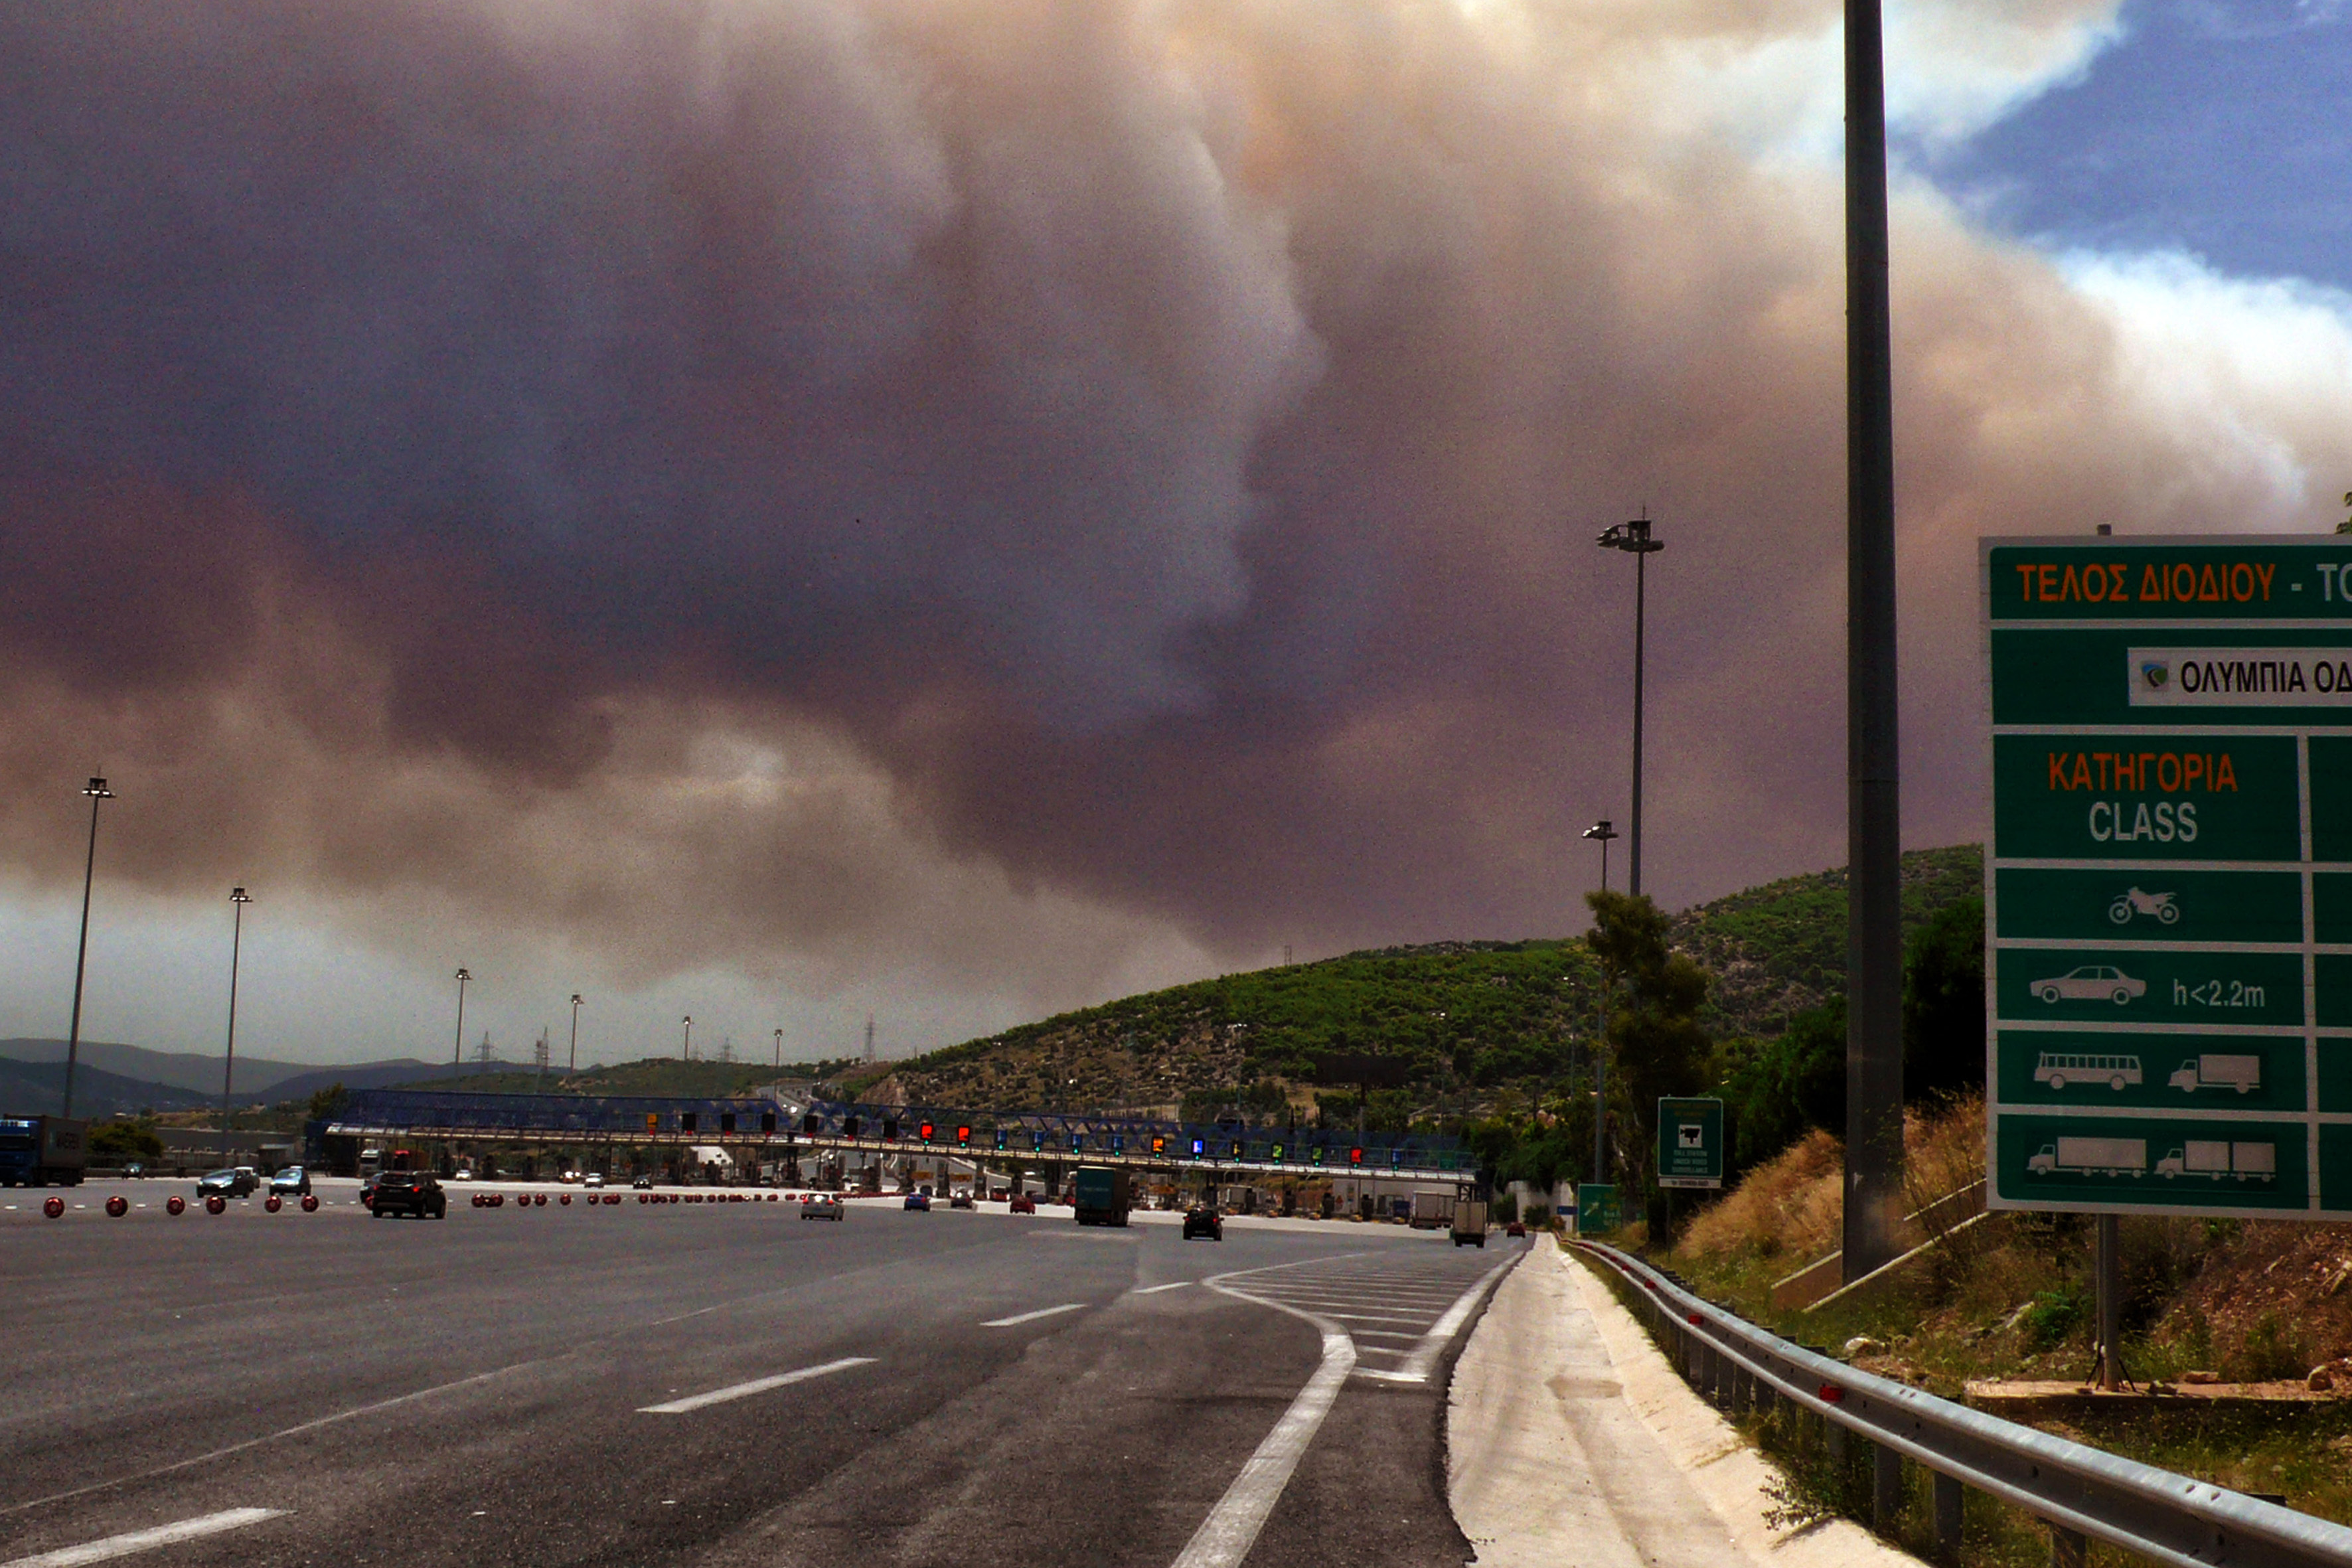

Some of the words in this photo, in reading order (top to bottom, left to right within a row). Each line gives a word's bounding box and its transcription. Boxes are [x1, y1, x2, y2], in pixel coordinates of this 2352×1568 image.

[2017, 564, 2128, 601] ΤΕΛΟΣ
[2140, 564, 2274, 601] ΔΙΟΔΙΟΥ
[2181, 661, 2306, 692] ΟΛΥΜΠΙΑ
[2314, 661, 2352, 693] ΟΔ
[2050, 753, 2236, 791] ΚΑΤΗΓΟΡΙΑ
[2090, 802, 2197, 841] CLASS
[2174, 979, 2265, 1006] h<2.2m
